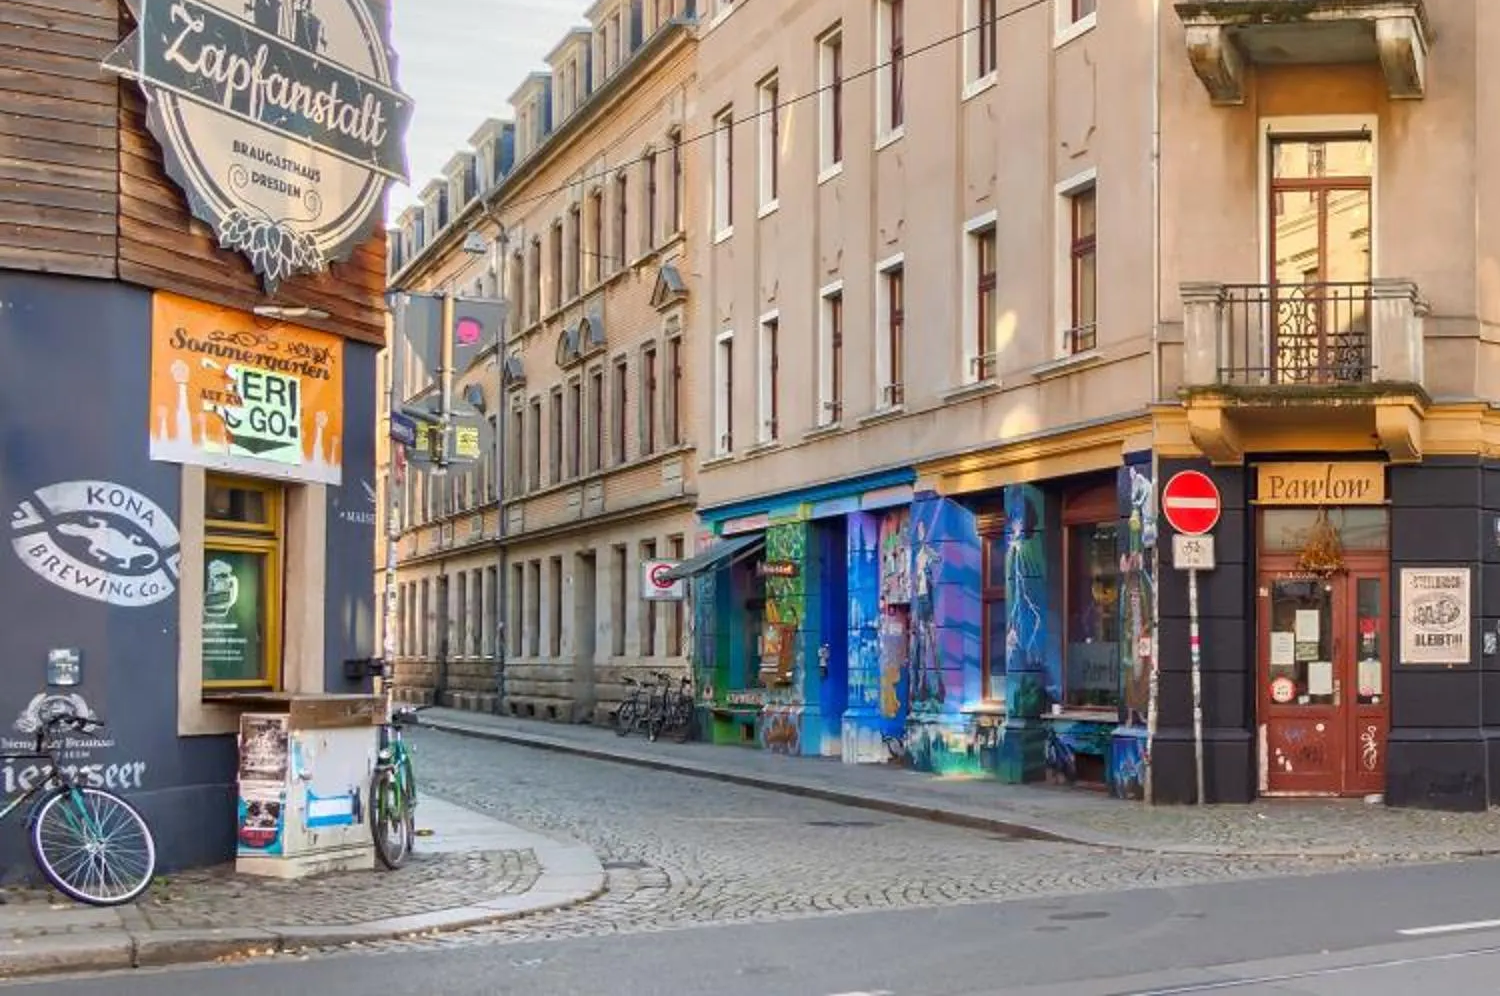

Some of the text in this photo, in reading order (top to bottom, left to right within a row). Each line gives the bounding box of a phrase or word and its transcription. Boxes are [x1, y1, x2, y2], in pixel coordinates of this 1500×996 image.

[161, 2, 388, 147] Zapfanstalt
[232, 140, 322, 184] BRAUGASTHAUS
[250, 171, 302, 199] DRESDEN
[169, 326, 331, 381] Sommergarten
[1269, 464, 1372, 501] Pawlow
[86, 485, 156, 527] KONA
[28, 542, 134, 598] BREWING
